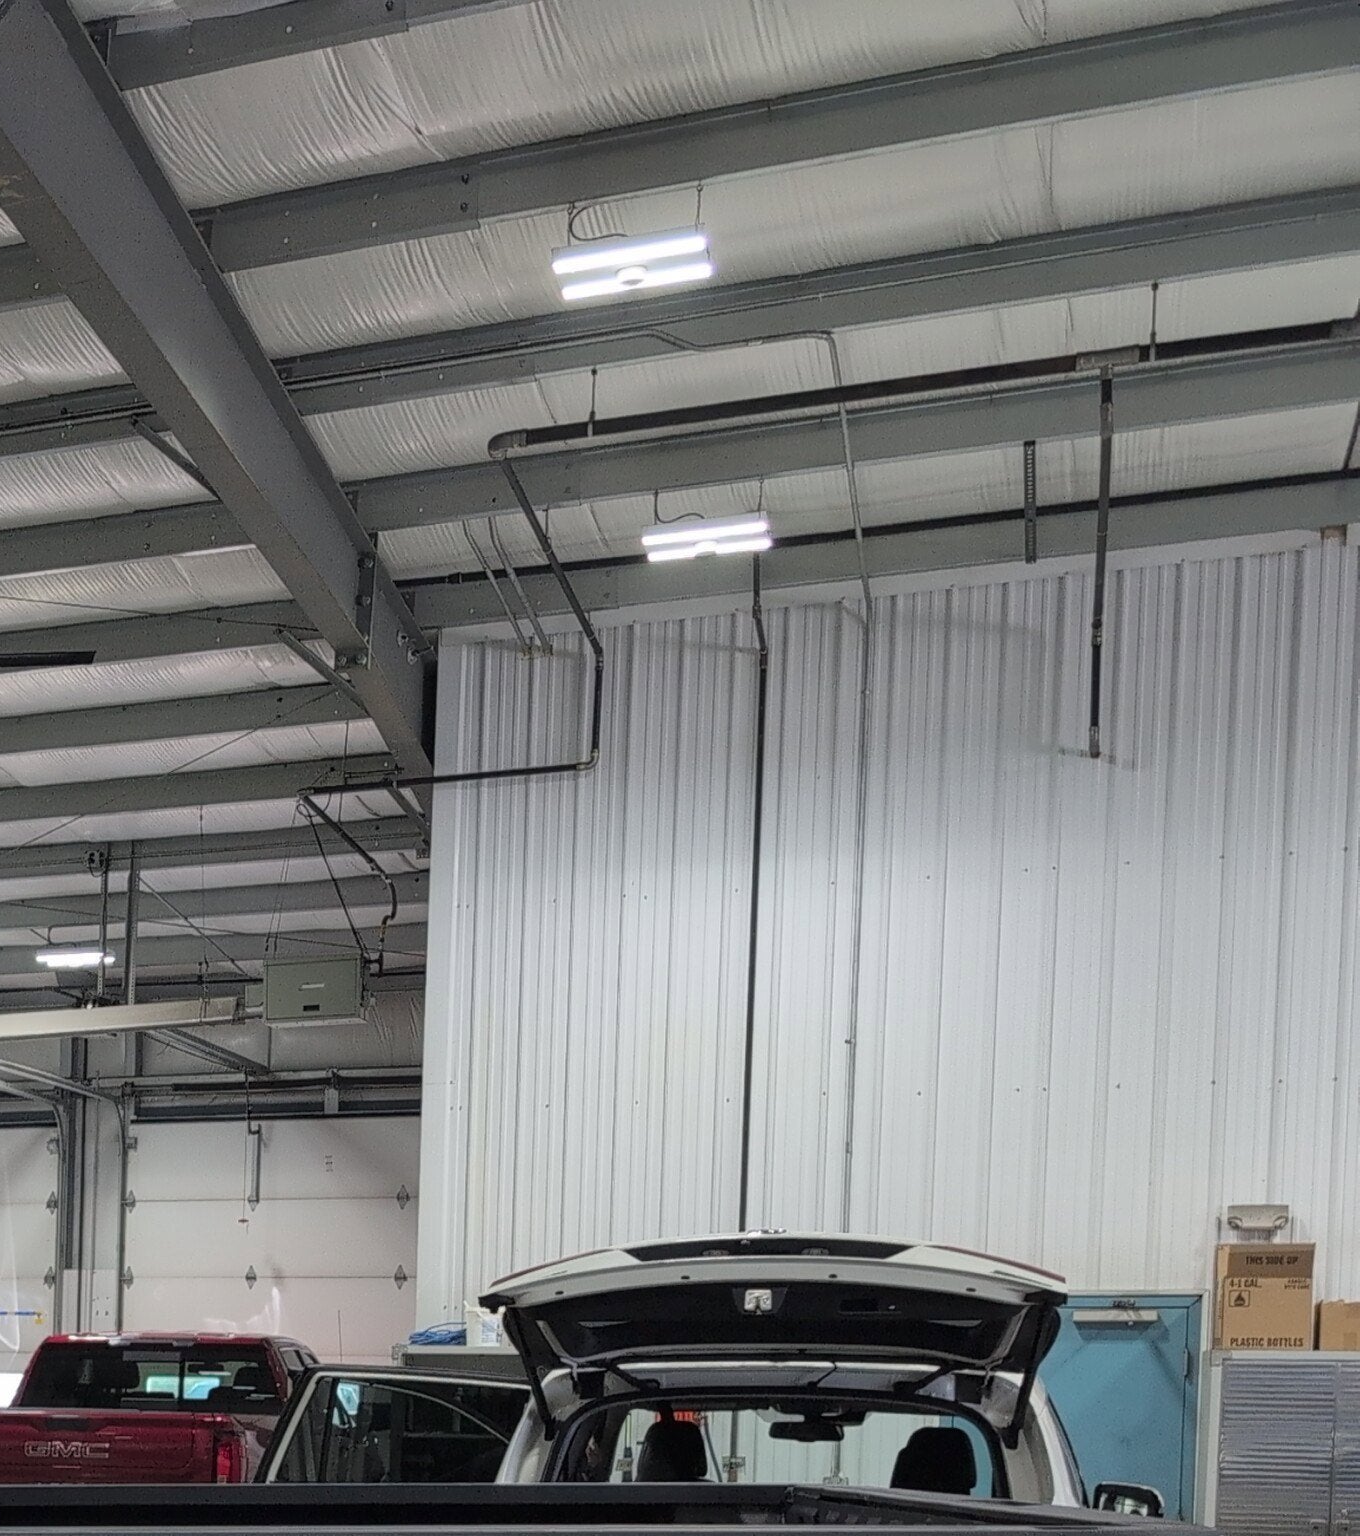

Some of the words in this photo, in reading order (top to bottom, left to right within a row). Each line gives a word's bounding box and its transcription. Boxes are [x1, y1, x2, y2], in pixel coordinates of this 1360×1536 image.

[1230, 1337, 1264, 1347] PLASTIC
[1266, 1337, 1304, 1348] BOTTLES
[24, 1441, 110, 1459] GMC
